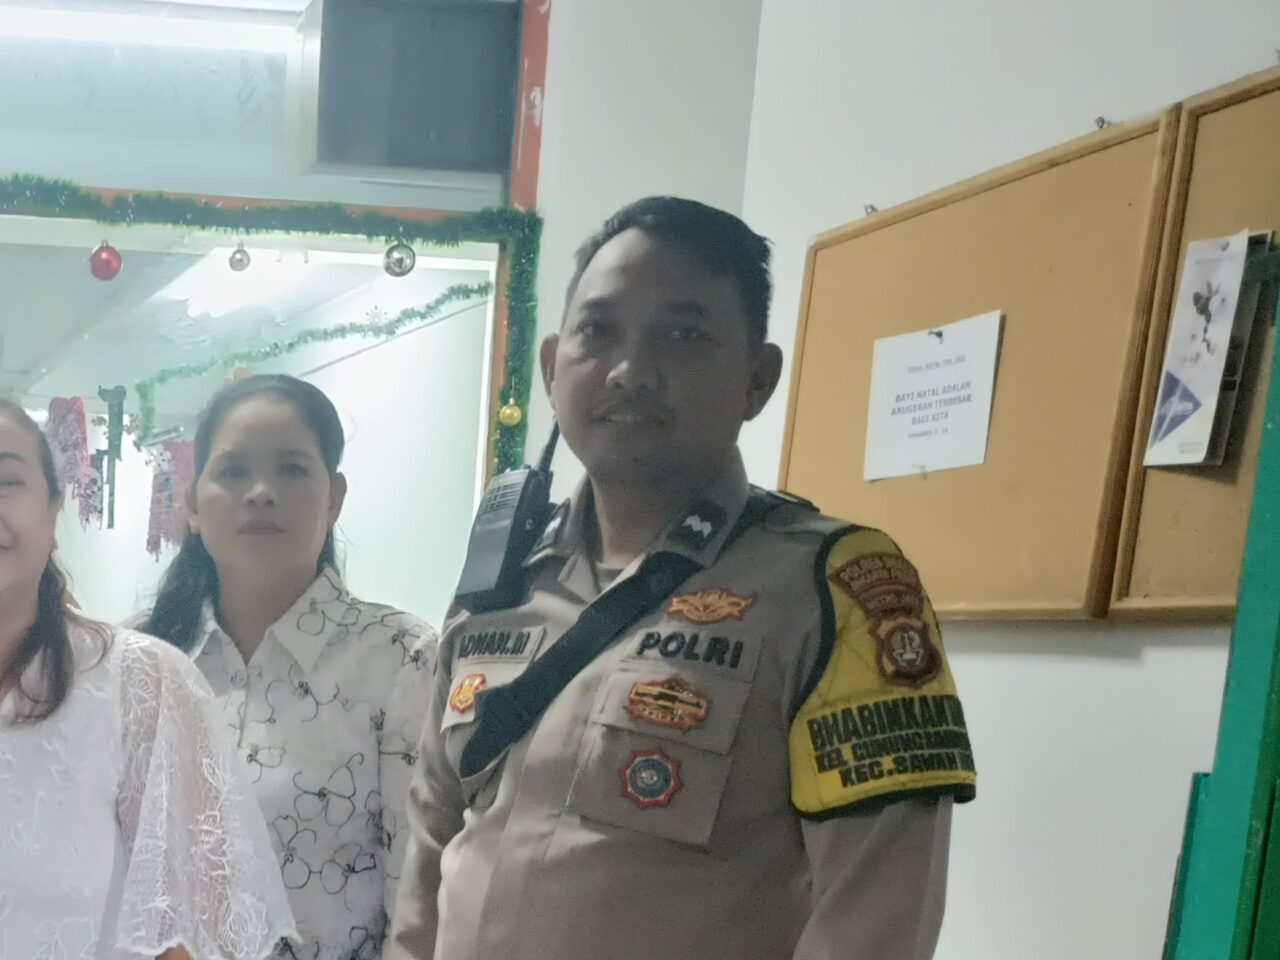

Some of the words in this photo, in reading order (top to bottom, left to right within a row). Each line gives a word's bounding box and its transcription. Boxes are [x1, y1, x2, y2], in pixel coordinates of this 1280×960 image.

[895, 391, 915, 403] BAYI
[916, 387, 939, 399] NATAL
[941, 381, 970, 393] ADALAH
[891, 400, 933, 416] ANUGERAH
[935, 394, 971, 407] TERBESAR
[911, 413, 930, 426] BAGI
[931, 411, 949, 422] KITA
[636, 631, 744, 669] POLRI
